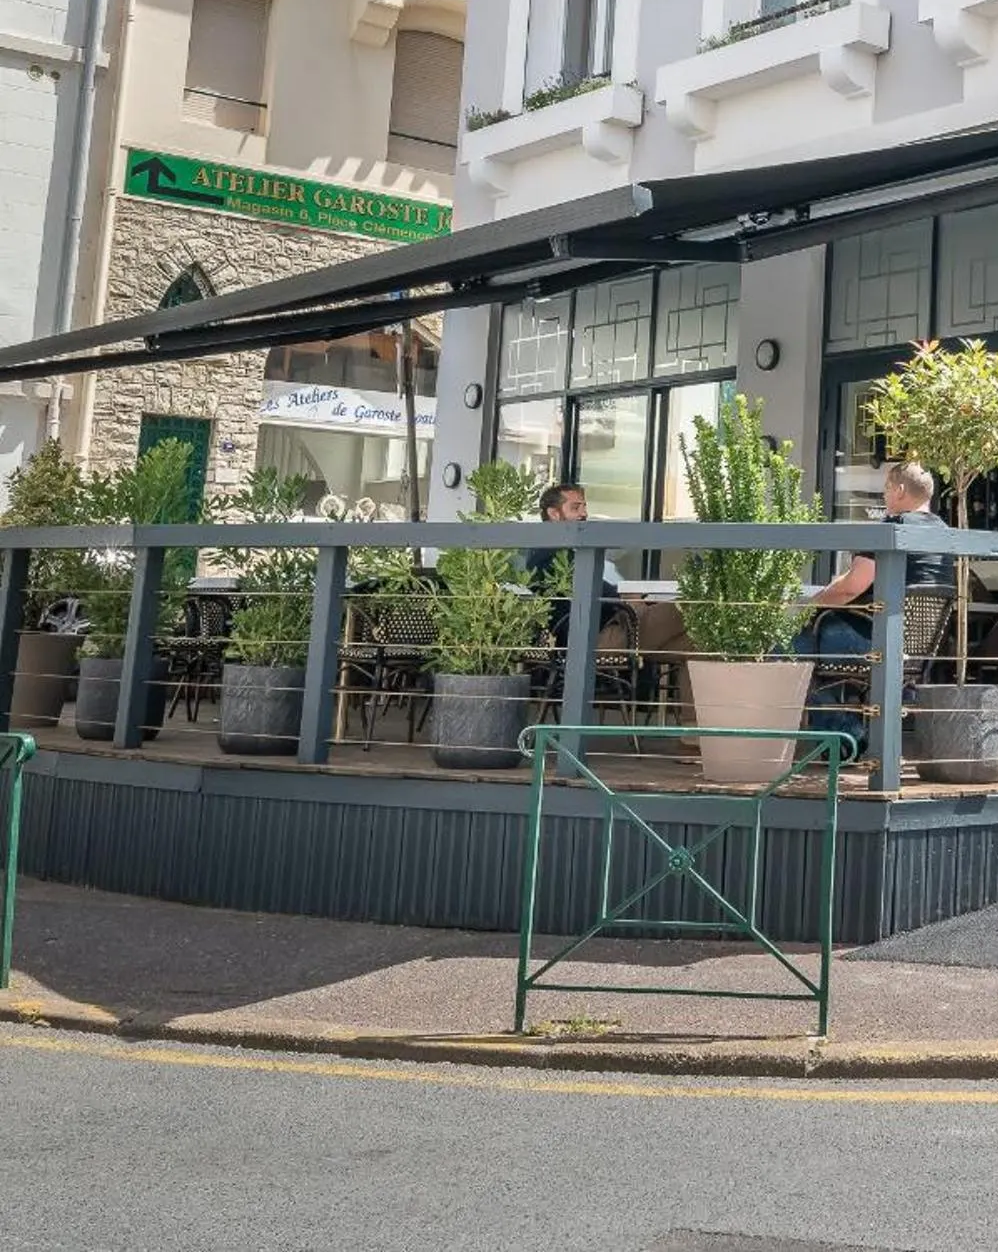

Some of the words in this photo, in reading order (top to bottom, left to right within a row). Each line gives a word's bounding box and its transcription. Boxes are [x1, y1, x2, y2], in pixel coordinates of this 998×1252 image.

[192, 165, 305, 203] ATELIER
[314, 188, 428, 227] GAROSTE
[228, 197, 294, 219] Magasin
[319, 211, 357, 230] Place
[288, 386, 339, 408] Ateliers
[332, 402, 347, 416] de
[354, 405, 401, 422] Garoste
